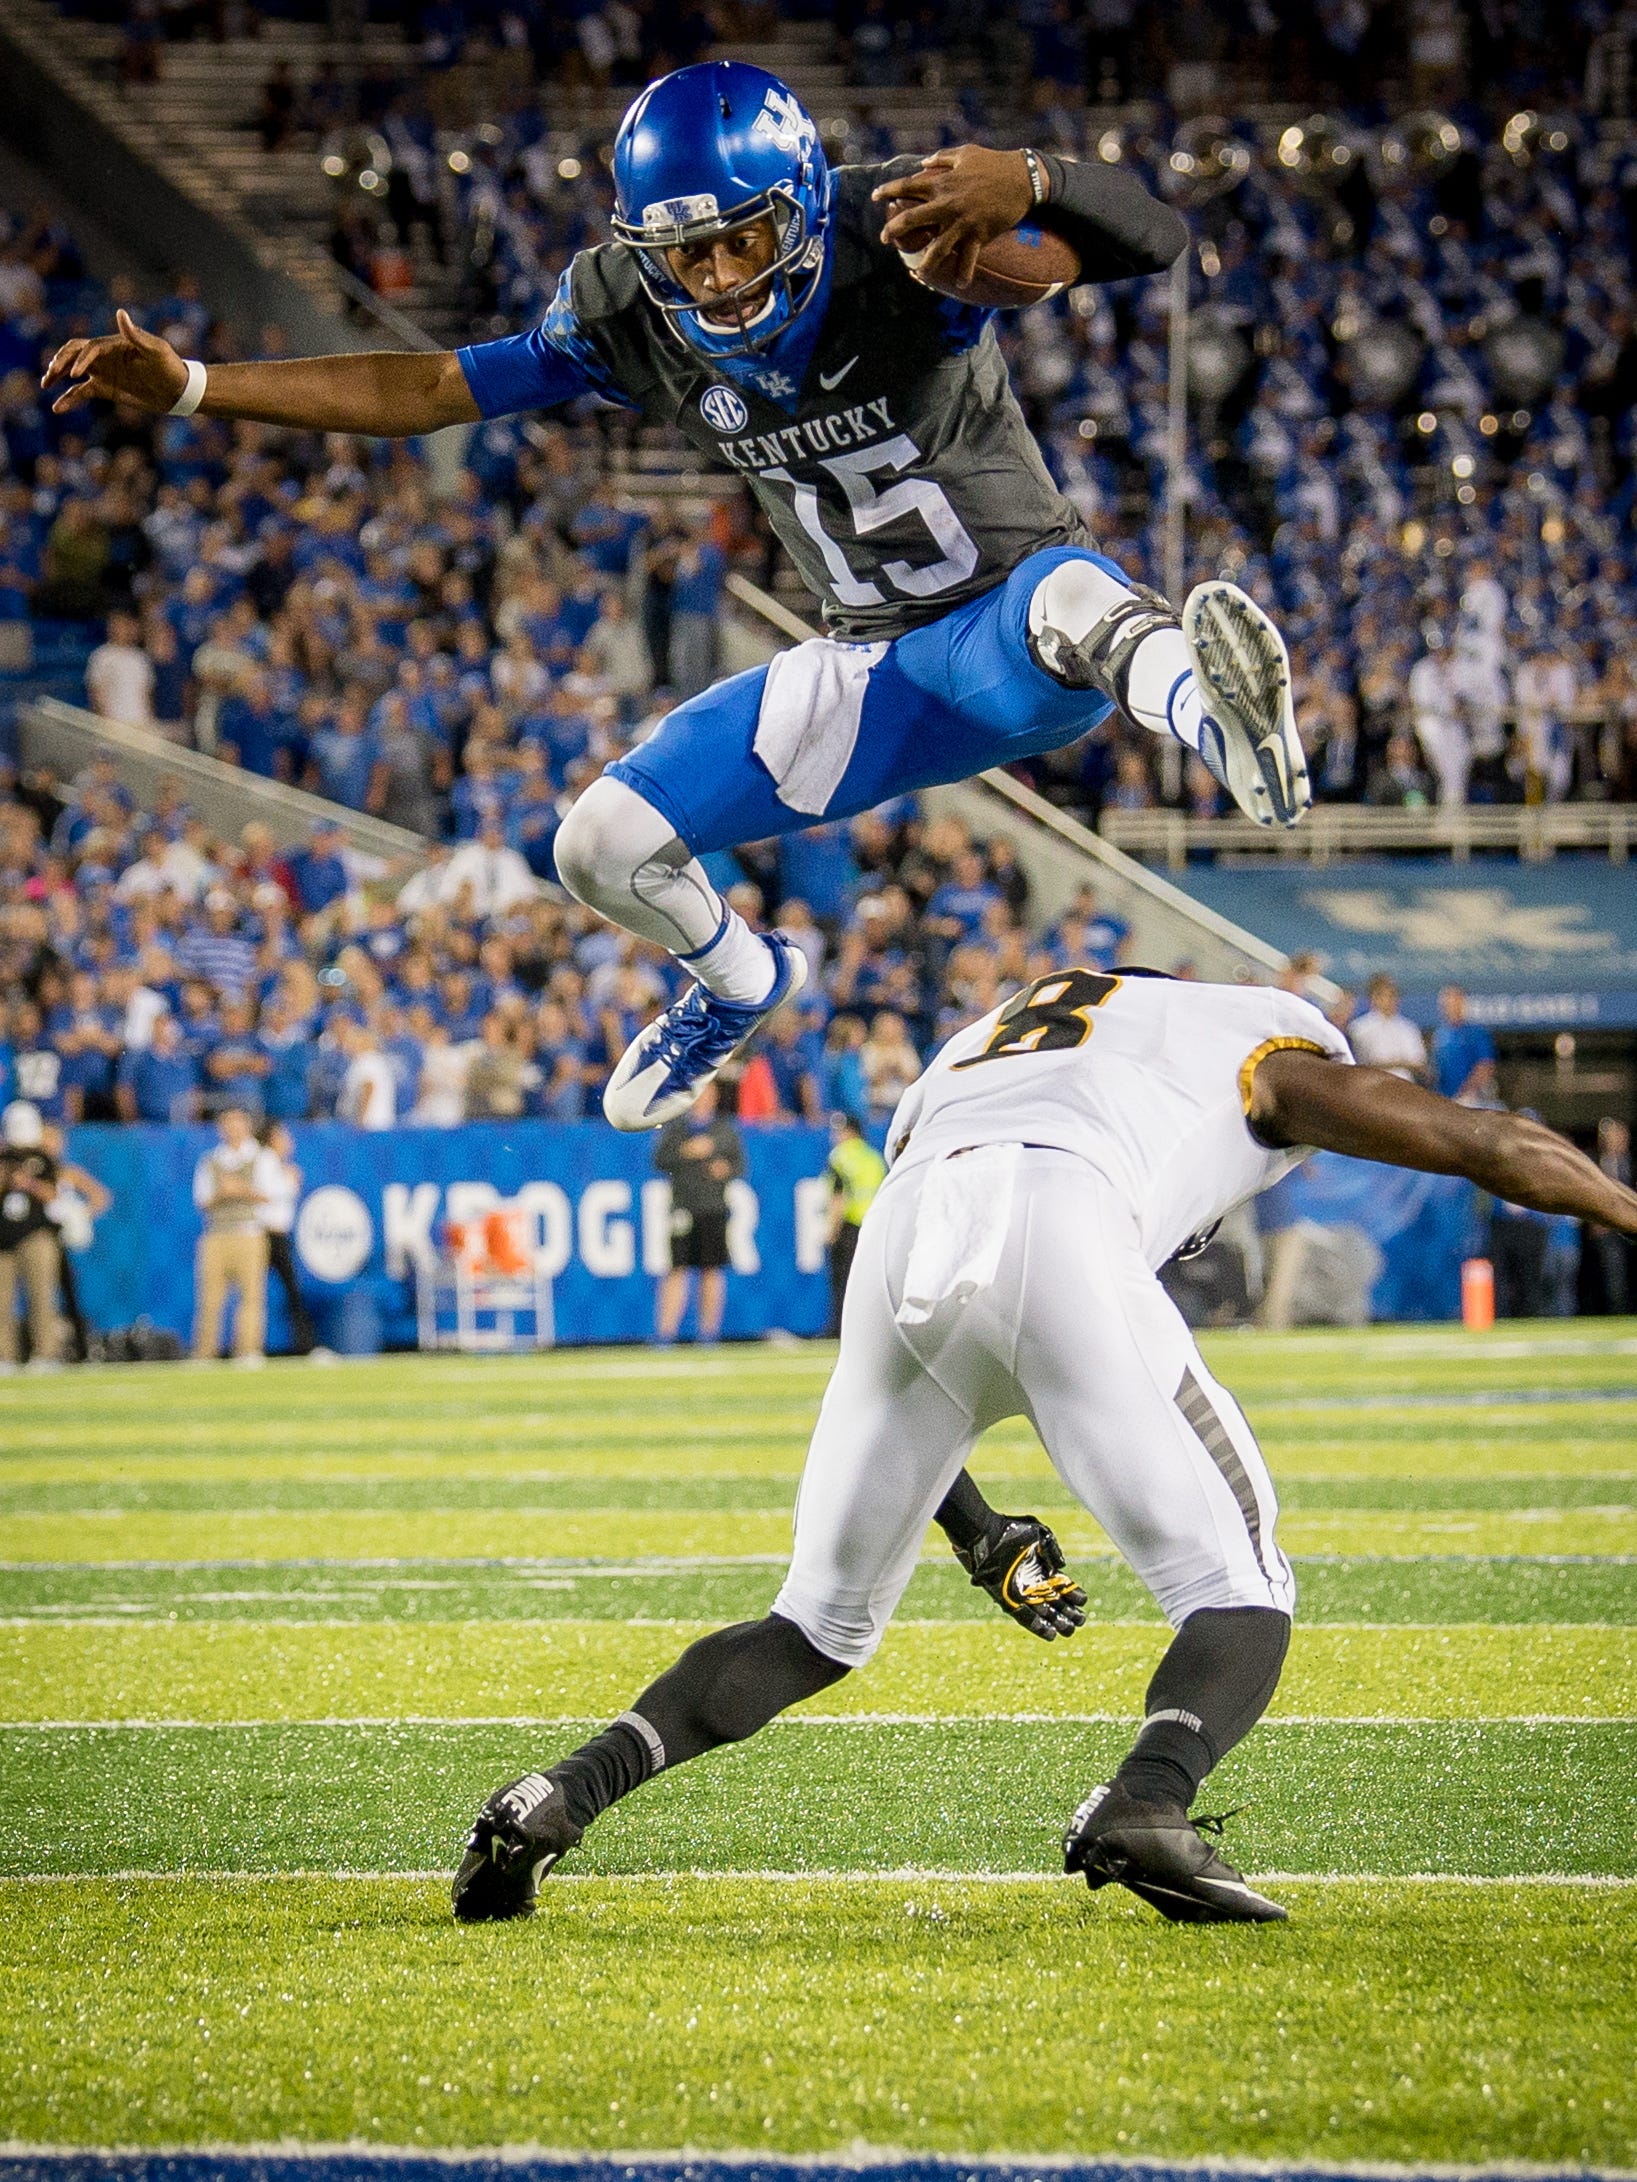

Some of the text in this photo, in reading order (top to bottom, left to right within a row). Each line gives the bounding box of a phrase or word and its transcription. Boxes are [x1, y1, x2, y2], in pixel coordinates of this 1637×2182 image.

[636, 248, 668, 283] NTUCKY
[704, 390, 744, 430] SEC
[756, 370, 796, 399] UK
[718, 396, 896, 468] KENTUCKY
[760, 433, 979, 607] 15
[949, 967, 1123, 1071] 8
[501, 1772, 554, 1823] NIKE
